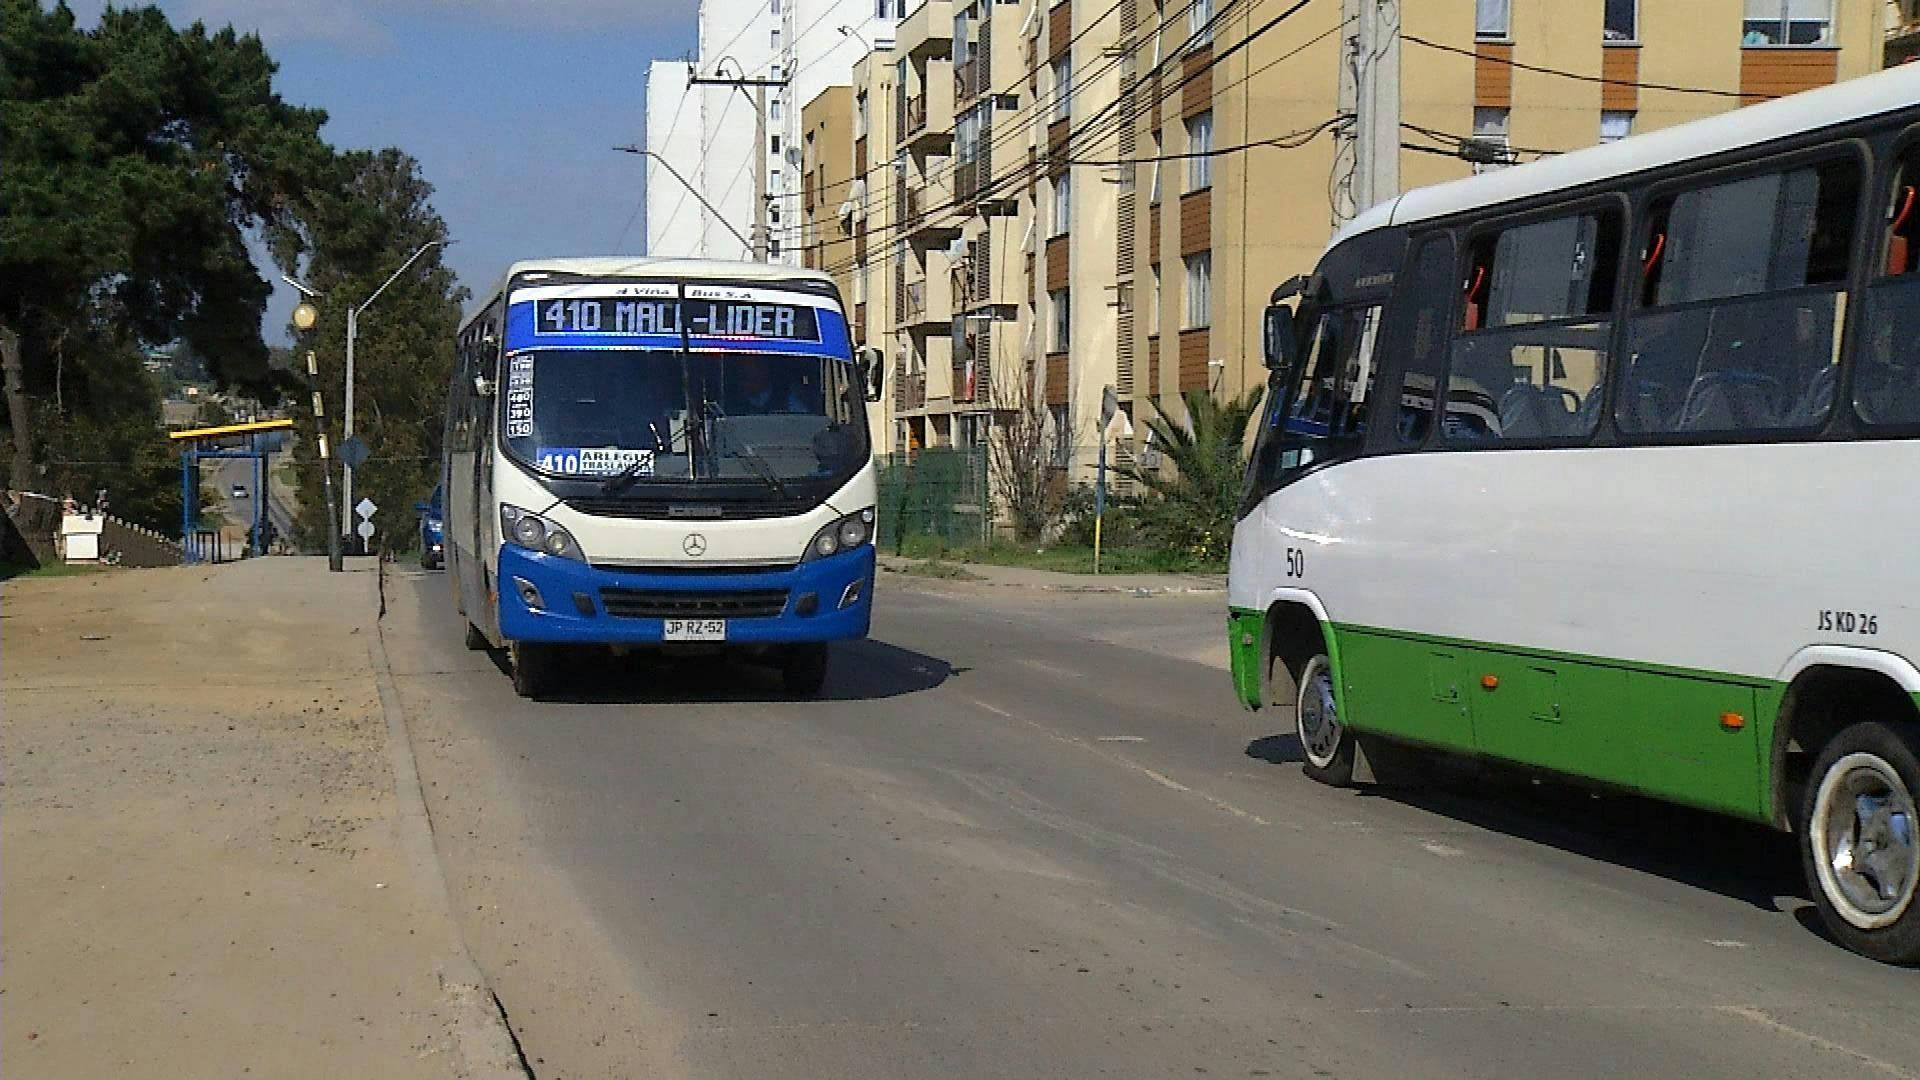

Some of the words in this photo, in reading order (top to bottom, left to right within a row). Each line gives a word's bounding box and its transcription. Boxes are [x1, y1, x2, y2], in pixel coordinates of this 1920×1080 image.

[545, 300, 601, 331] 410
[540, 453, 578, 474] 410
[1287, 547, 1304, 579] 50
[666, 621, 683, 634] JP
[1817, 609, 1833, 631] JS
[1836, 611, 1856, 633] KD
[1859, 613, 1878, 635] 26
